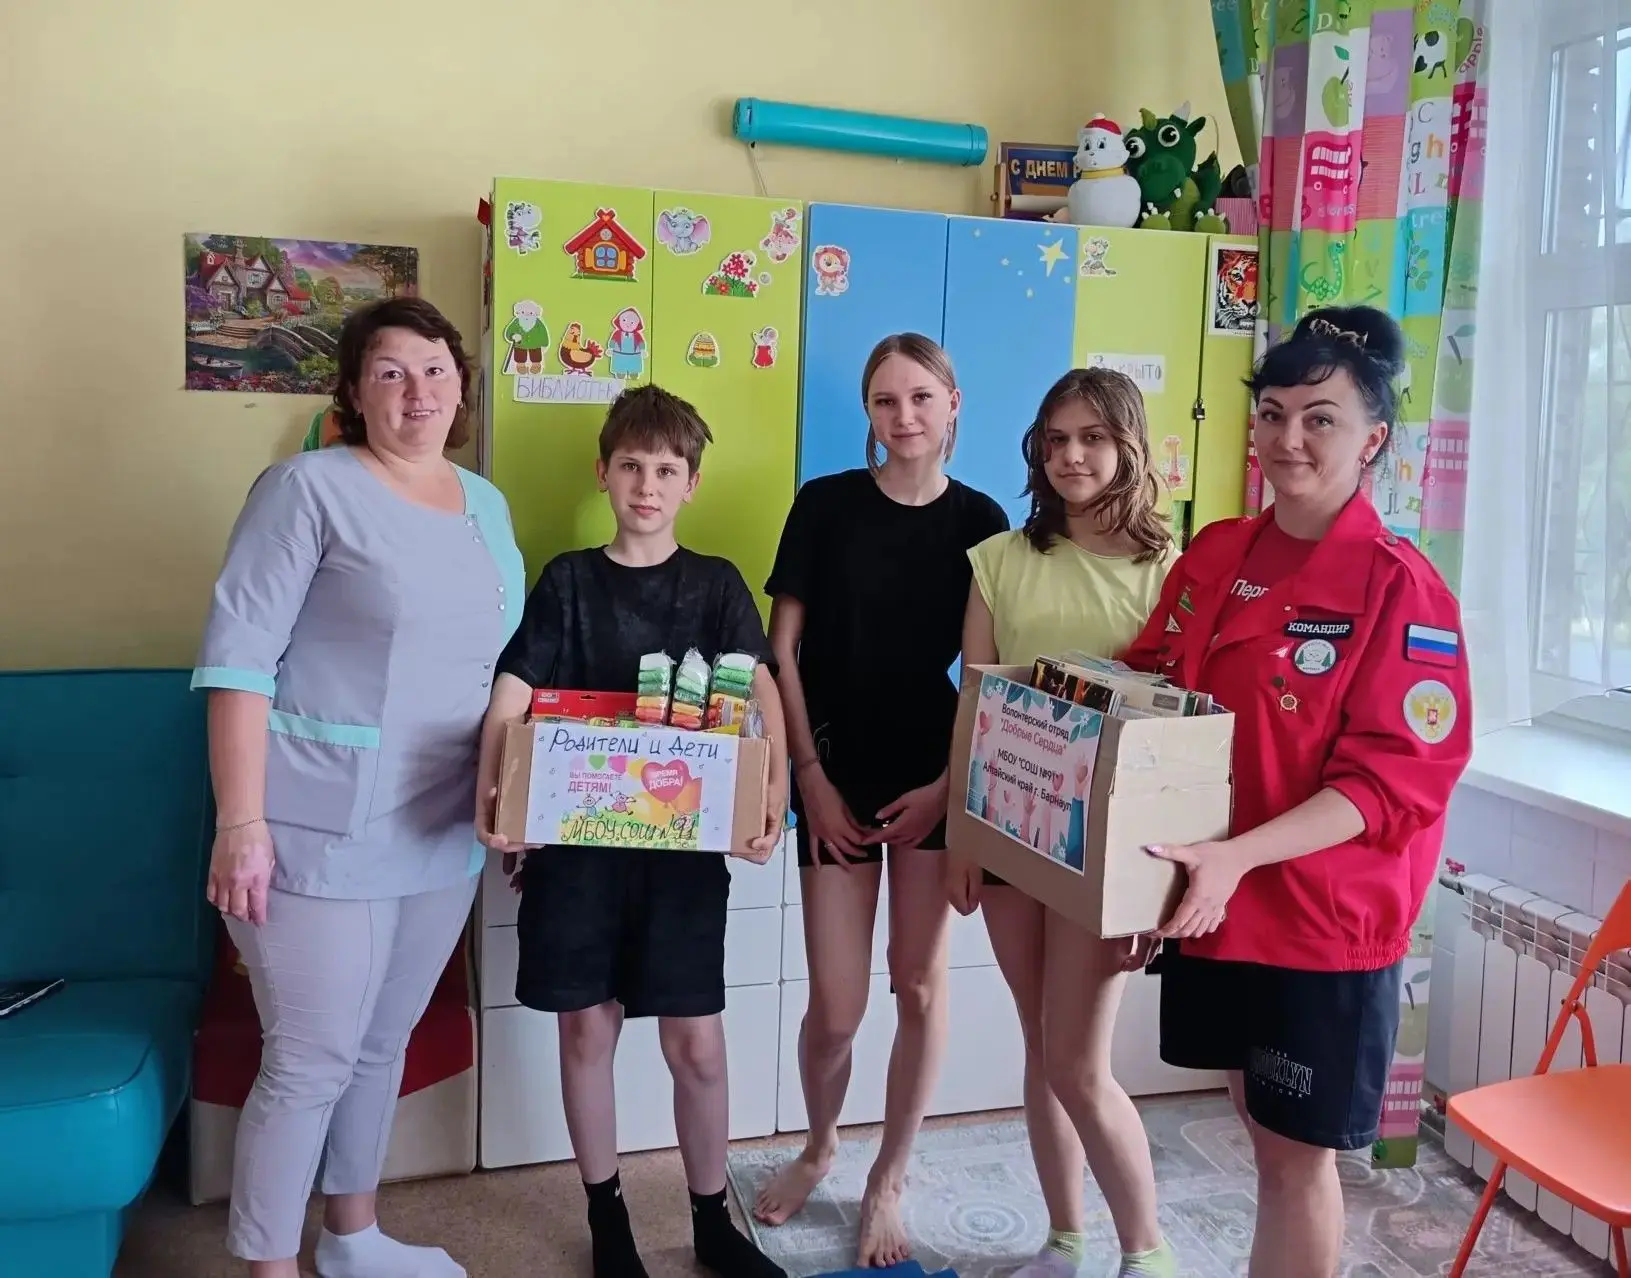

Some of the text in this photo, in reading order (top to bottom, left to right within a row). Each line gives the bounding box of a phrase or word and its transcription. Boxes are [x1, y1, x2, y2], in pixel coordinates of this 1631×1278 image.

[1010, 159, 1020, 175] С
[1025, 160, 1068, 179] ДНЕМ
[1288, 622, 1350, 635] КОМАНДИР
[1001, 703, 1069, 741] Волонтерский отряд
[549, 727, 719, 760] Родители и Дети
[997, 748, 1018, 765] МБОУ
[649, 775, 683, 790] ДОБРА!
[982, 760, 1017, 785] Алтайский
[1017, 778, 1033, 795] край
[568, 781, 612, 793] ДЕТЯМ!
